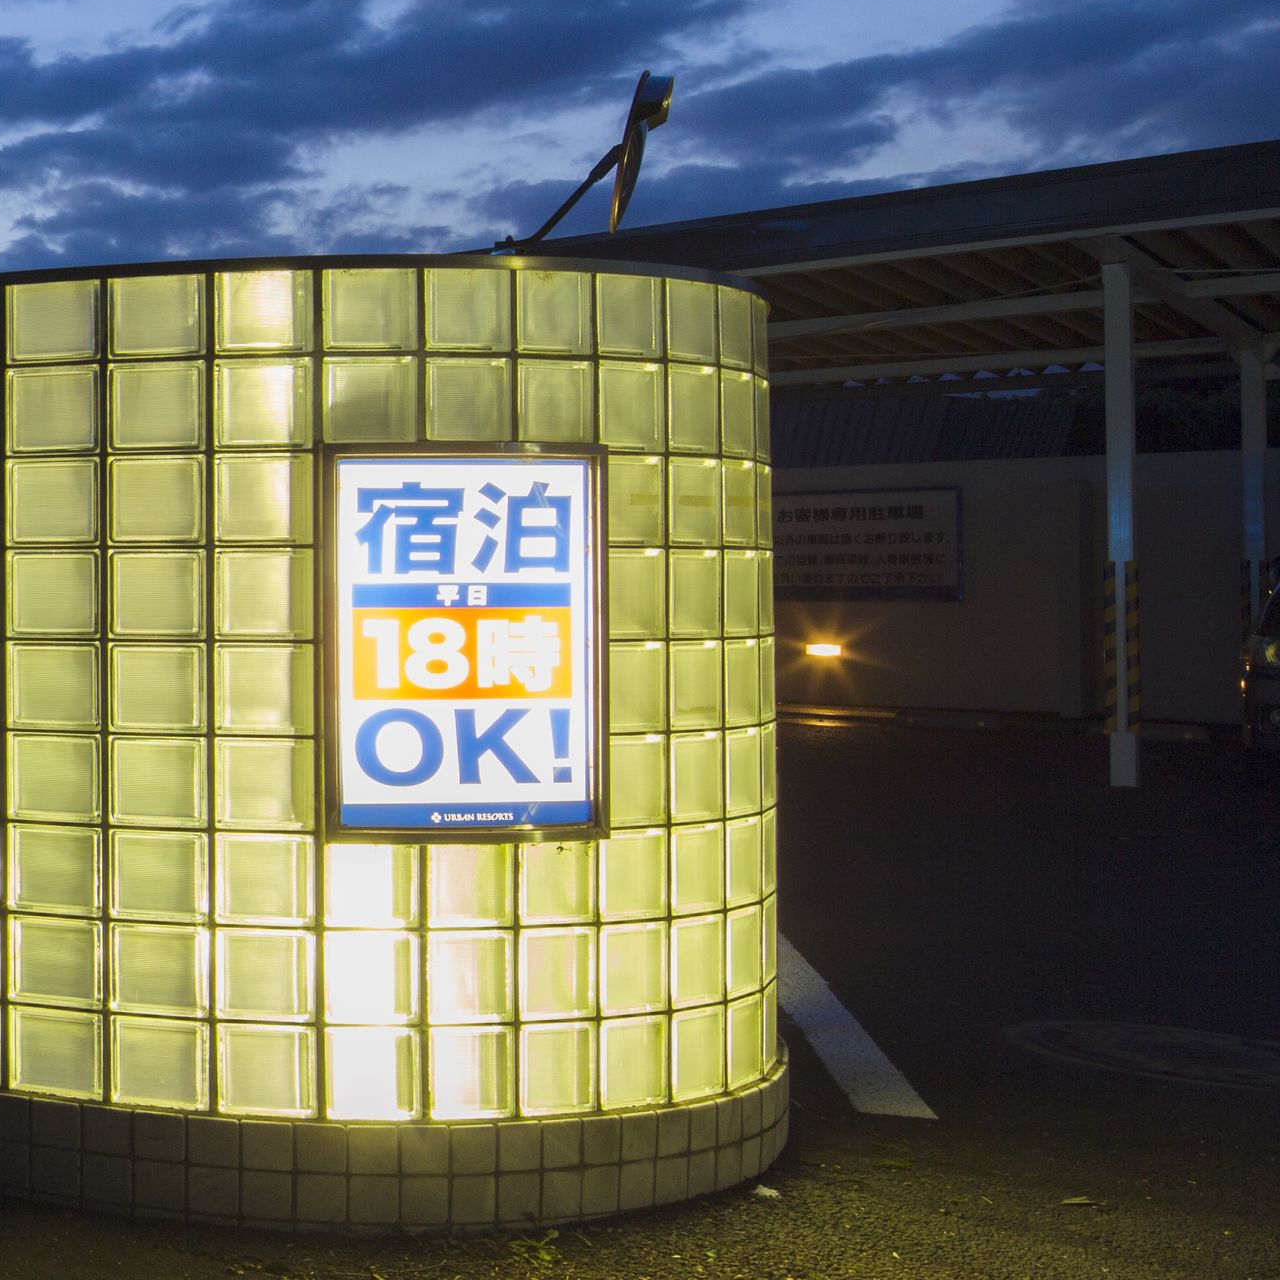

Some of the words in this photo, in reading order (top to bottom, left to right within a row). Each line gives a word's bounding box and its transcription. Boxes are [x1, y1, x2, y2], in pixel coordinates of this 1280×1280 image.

[354, 480, 572, 575] 宿泊
[778, 505, 924, 523] お客様専用駐車場
[436, 584, 488, 607] 平日
[363, 615, 561, 692] 18時
[354, 707, 574, 787] OK!
[443, 812, 475, 822] URBAN
[476, 811, 514, 821] RESORTS
